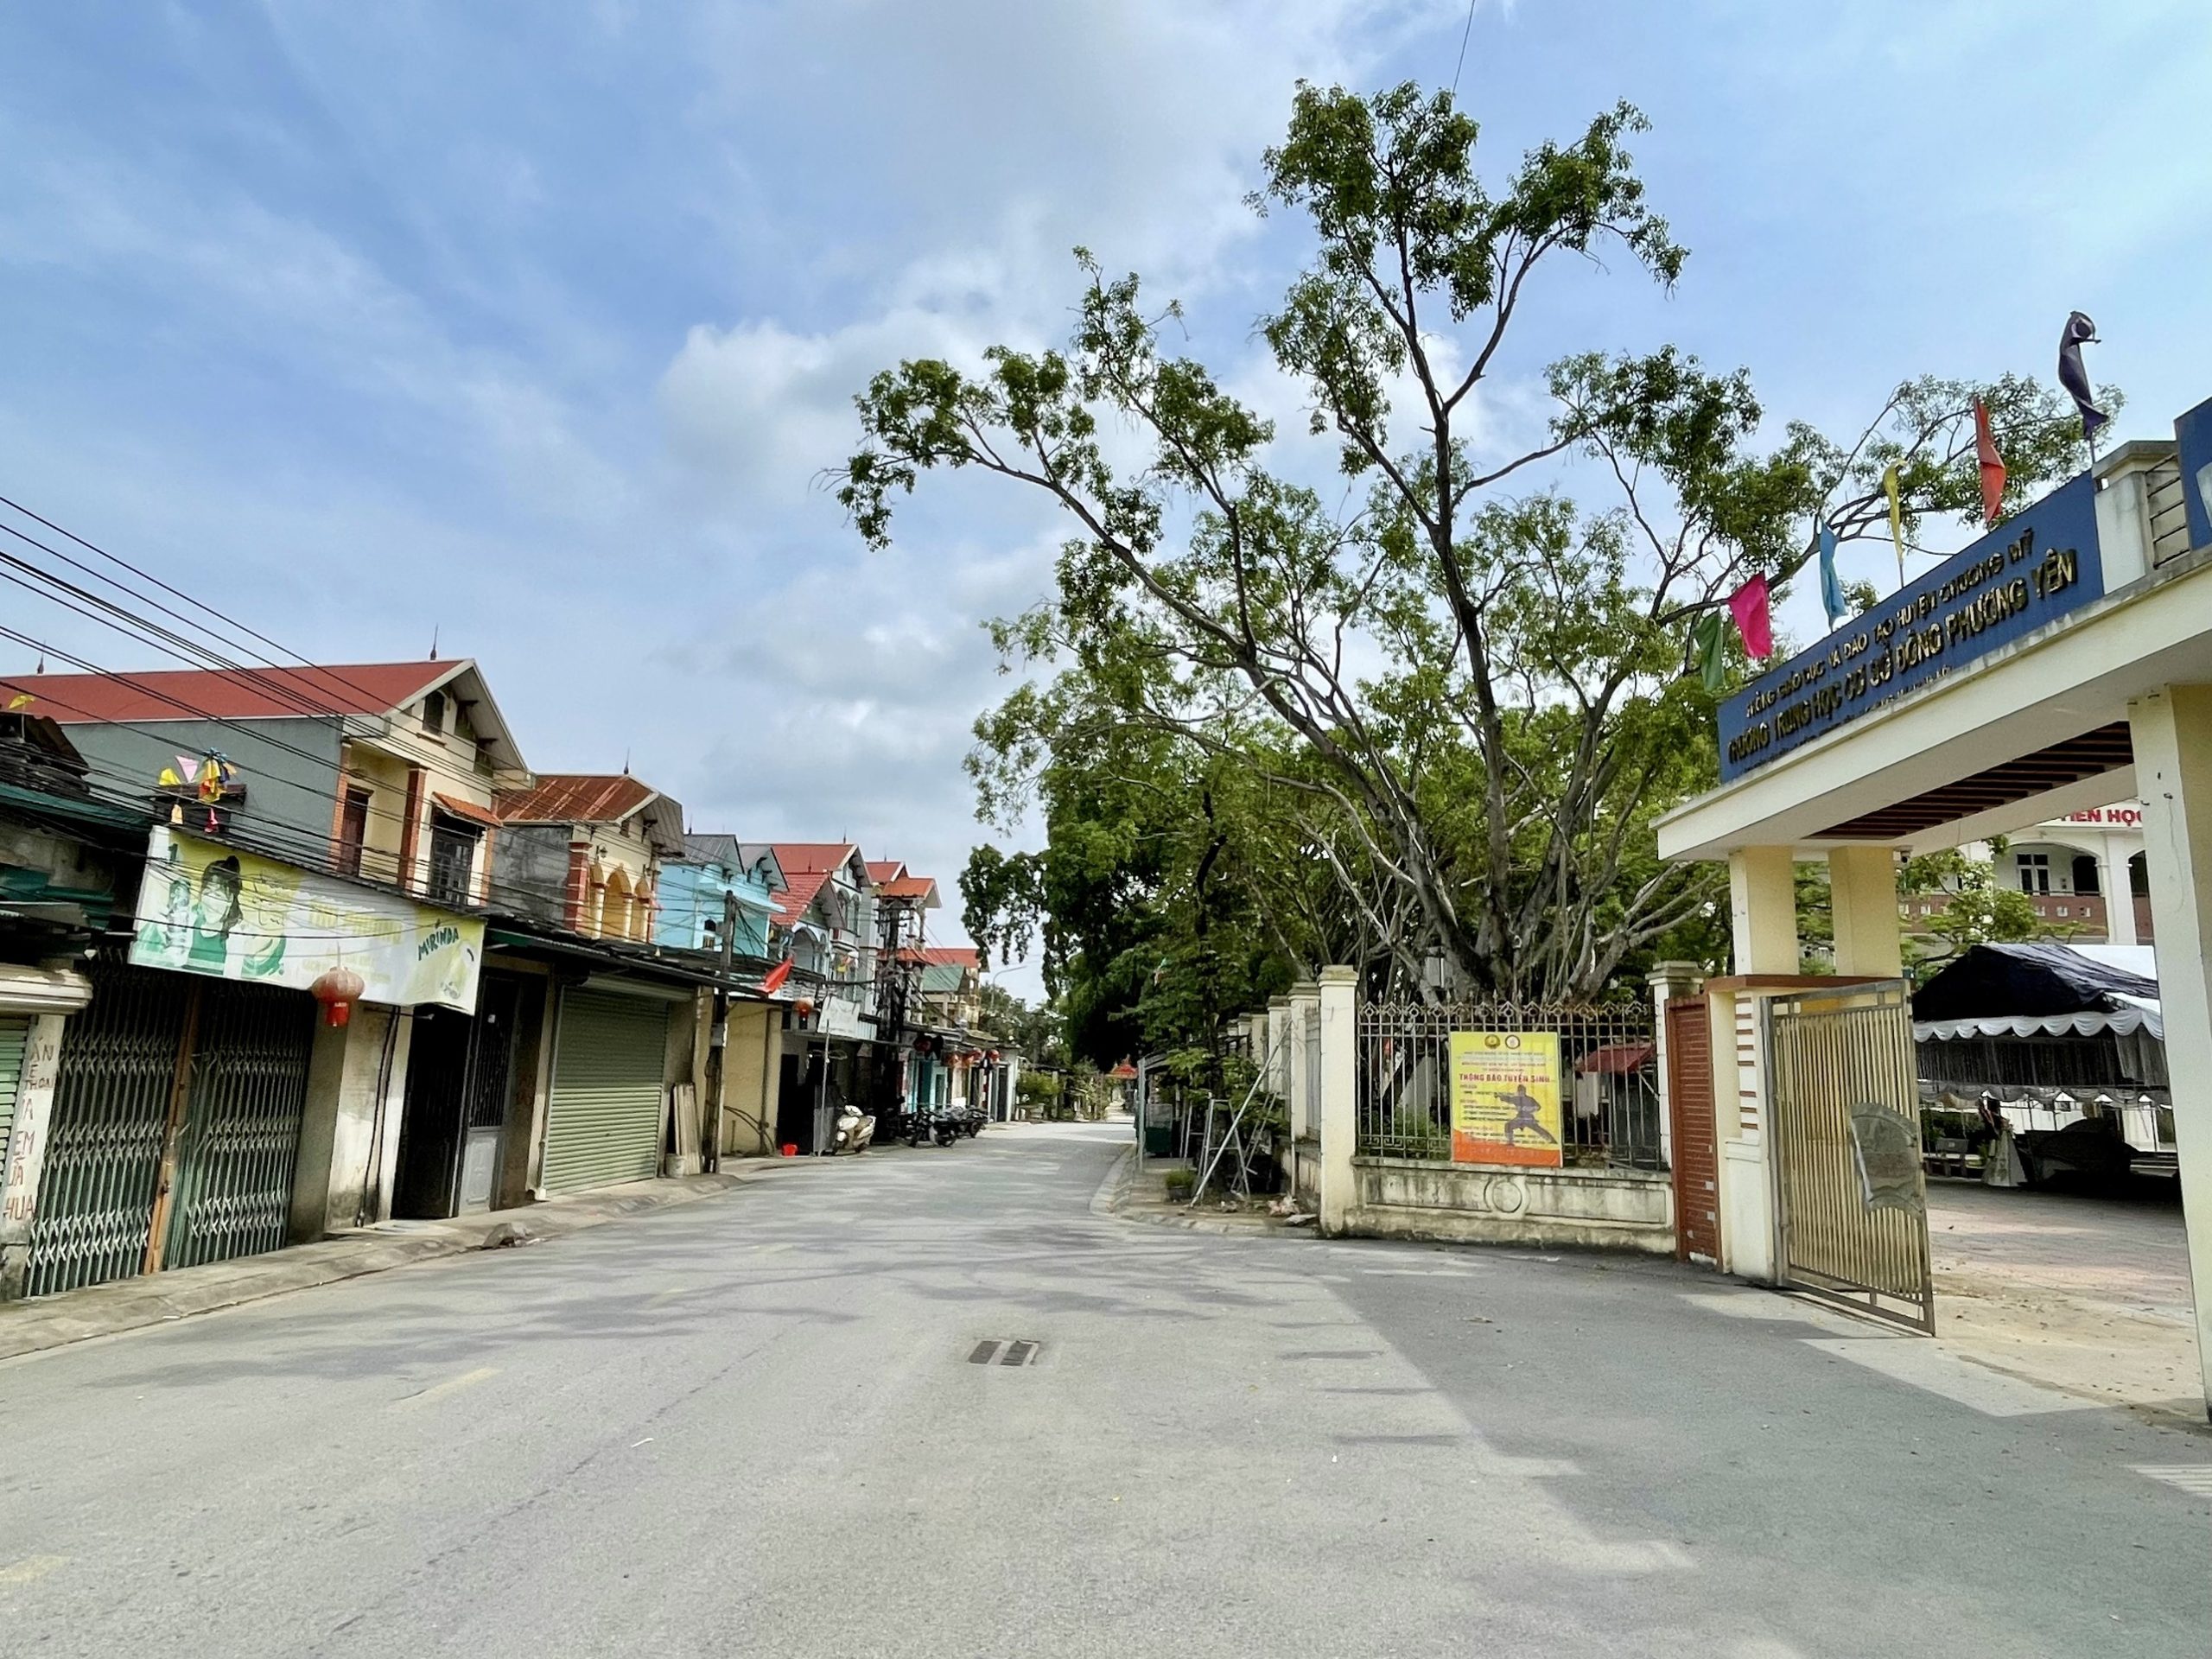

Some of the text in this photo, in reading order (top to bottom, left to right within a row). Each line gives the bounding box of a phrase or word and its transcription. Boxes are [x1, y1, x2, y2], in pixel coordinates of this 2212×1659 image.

[1776, 700, 1813, 741] TRUNG
[1813, 681, 1843, 721] HỌC
[2031, 548, 2078, 601] YÊN
[418, 926, 460, 961] MIRINDA
[1459, 1071, 1550, 1083] THÔNG BÁO TUYỂN SINH
